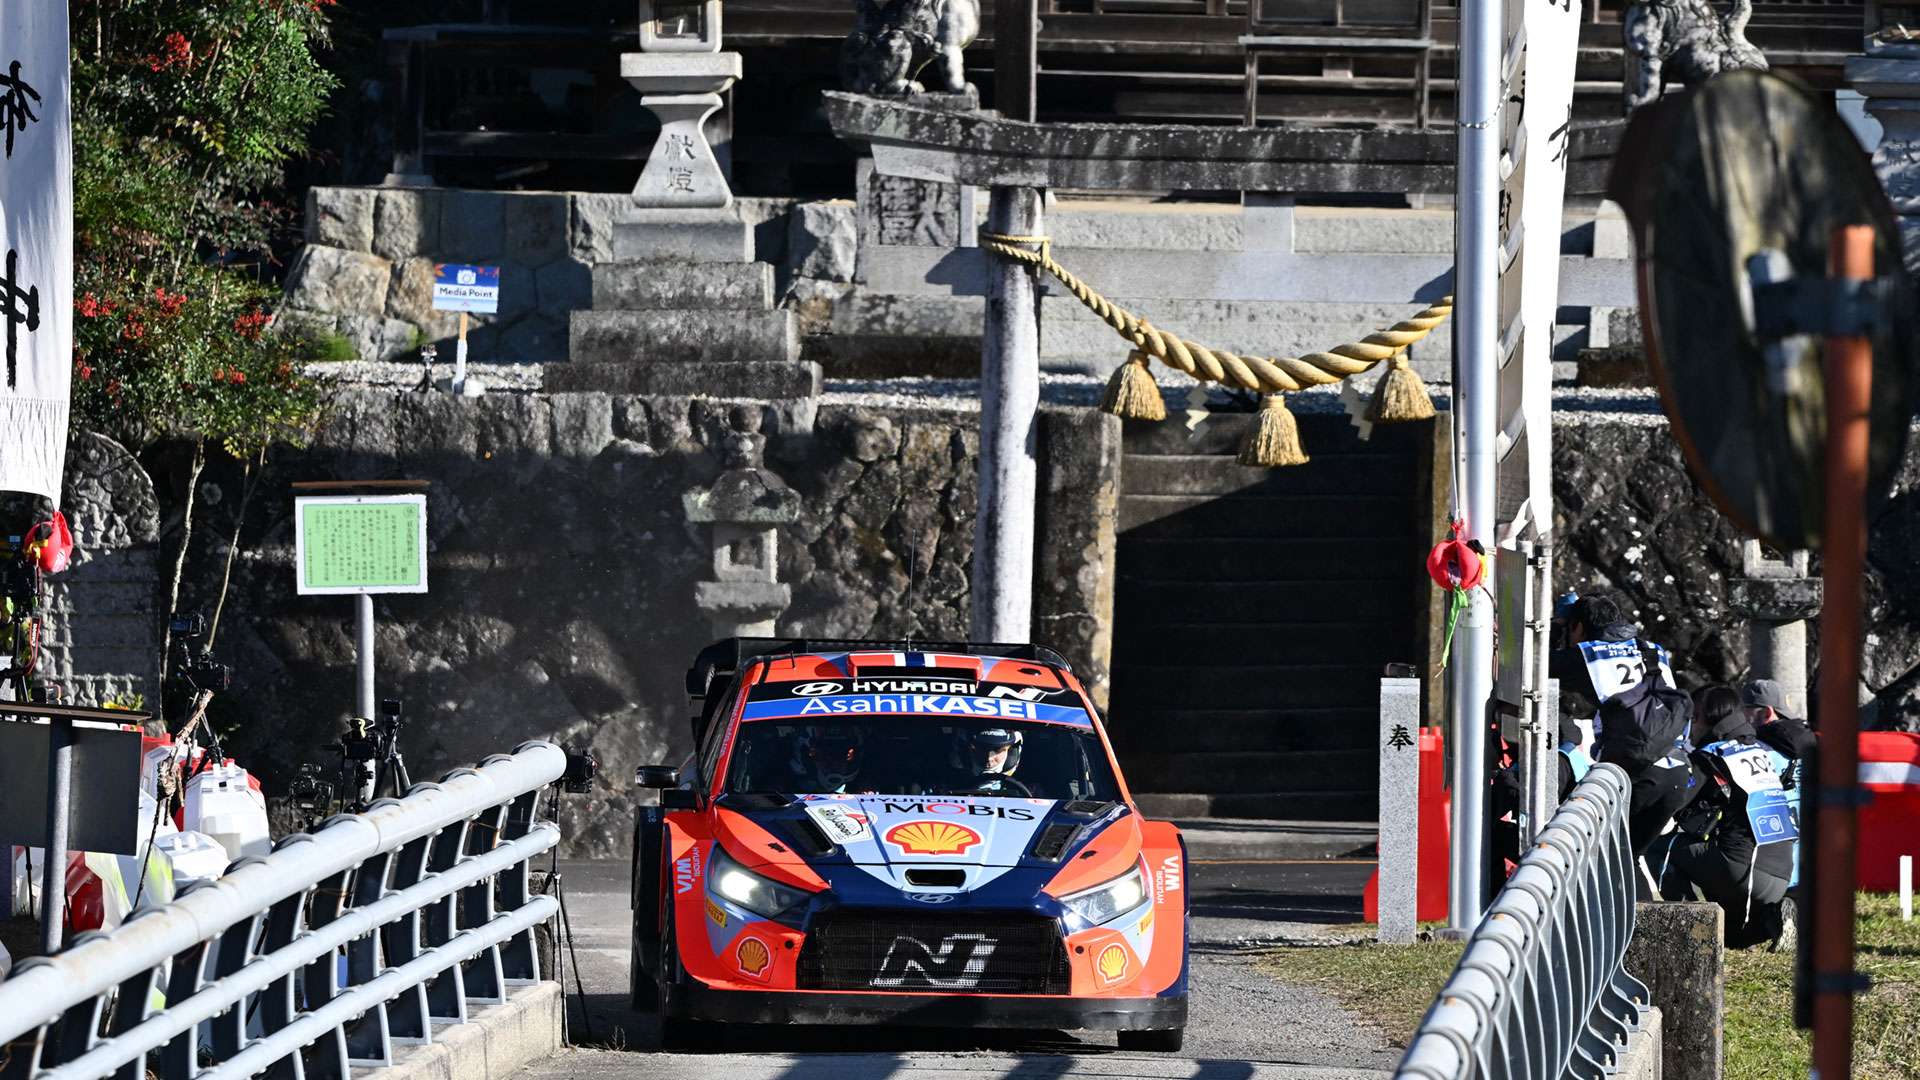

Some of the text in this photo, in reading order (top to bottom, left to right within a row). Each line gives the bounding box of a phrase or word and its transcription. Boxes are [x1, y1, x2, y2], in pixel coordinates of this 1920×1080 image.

[439, 287, 493, 298] Media Point
[852, 681, 977, 693] HYUNDAI
[1386, 724, 1415, 751] 奉
[884, 802, 1035, 821] MOBIS
